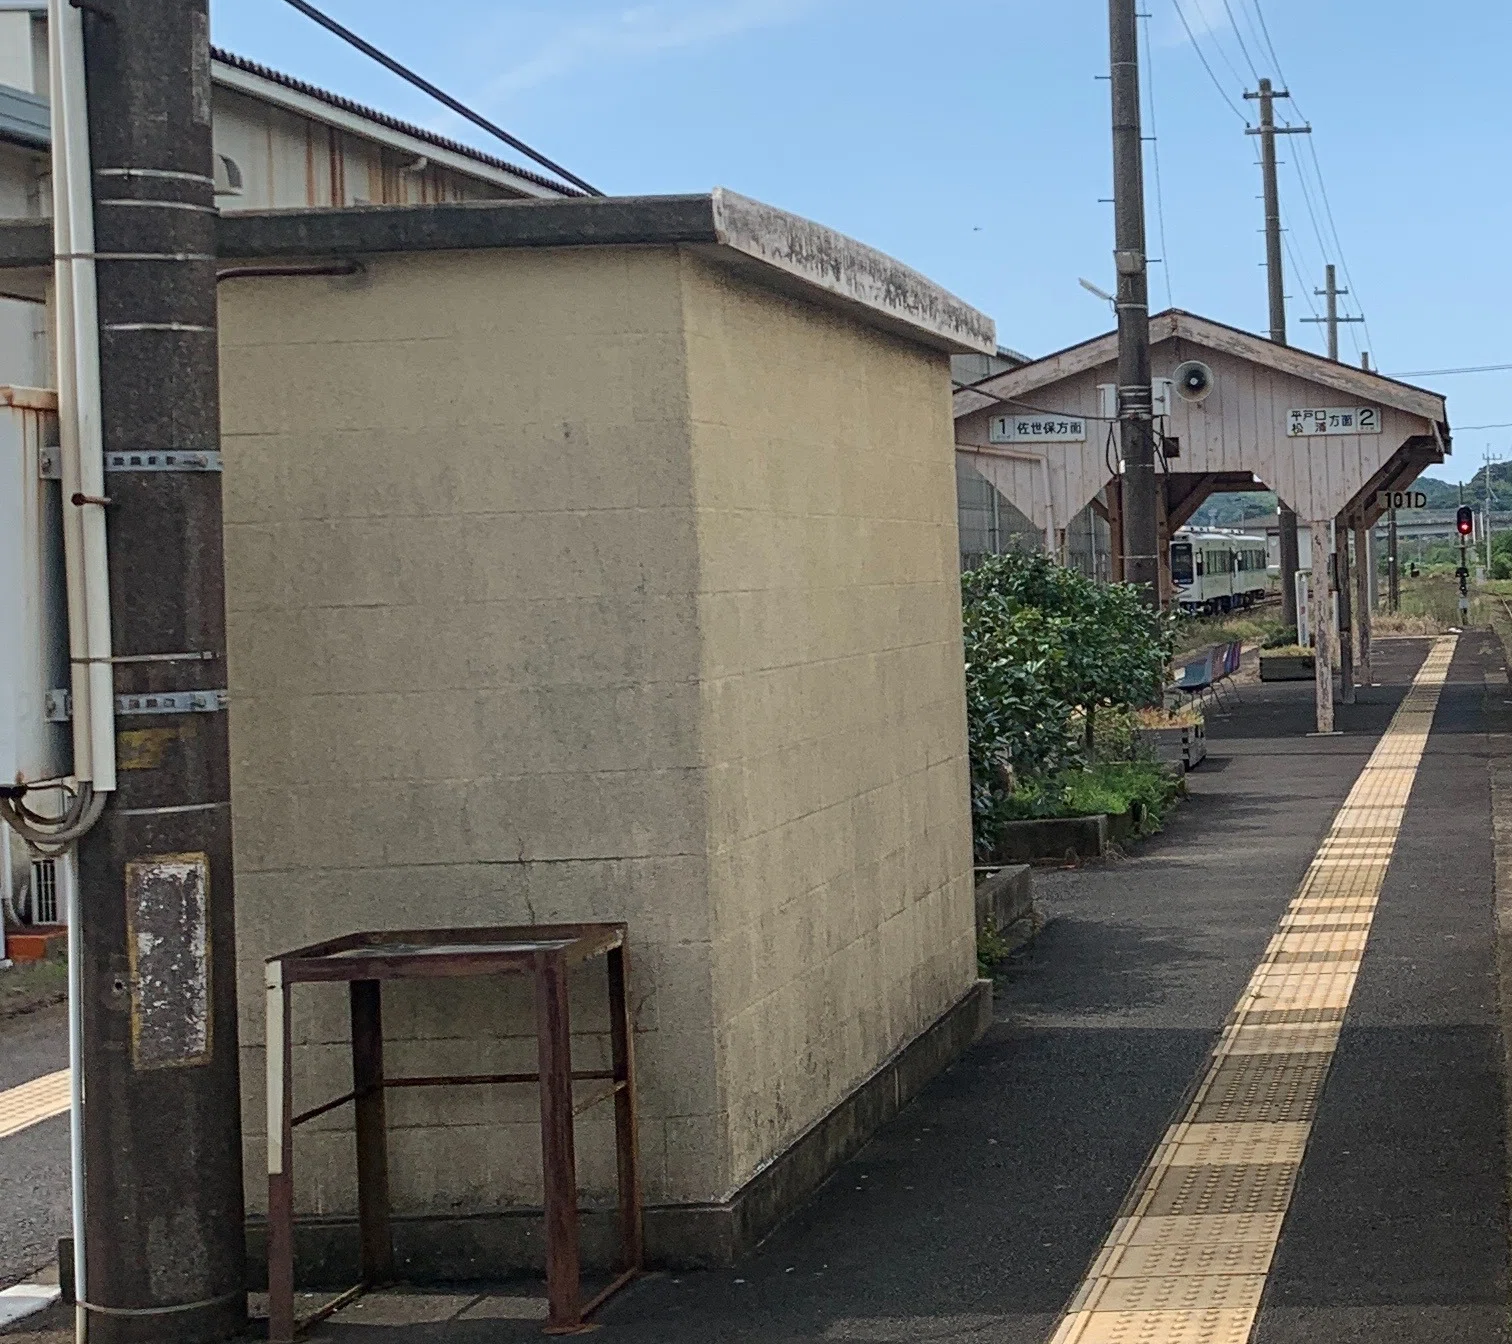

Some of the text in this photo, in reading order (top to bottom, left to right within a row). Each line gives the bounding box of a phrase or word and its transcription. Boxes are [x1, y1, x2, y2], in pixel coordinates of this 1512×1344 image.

[1291, 409, 1327, 421] 平戸口
[1328, 414, 1353, 427] 方面
[1359, 408, 1375, 426] 2
[998, 418, 1082, 435] 1 佐世保方面
[1385, 491, 1427, 509] 101D
